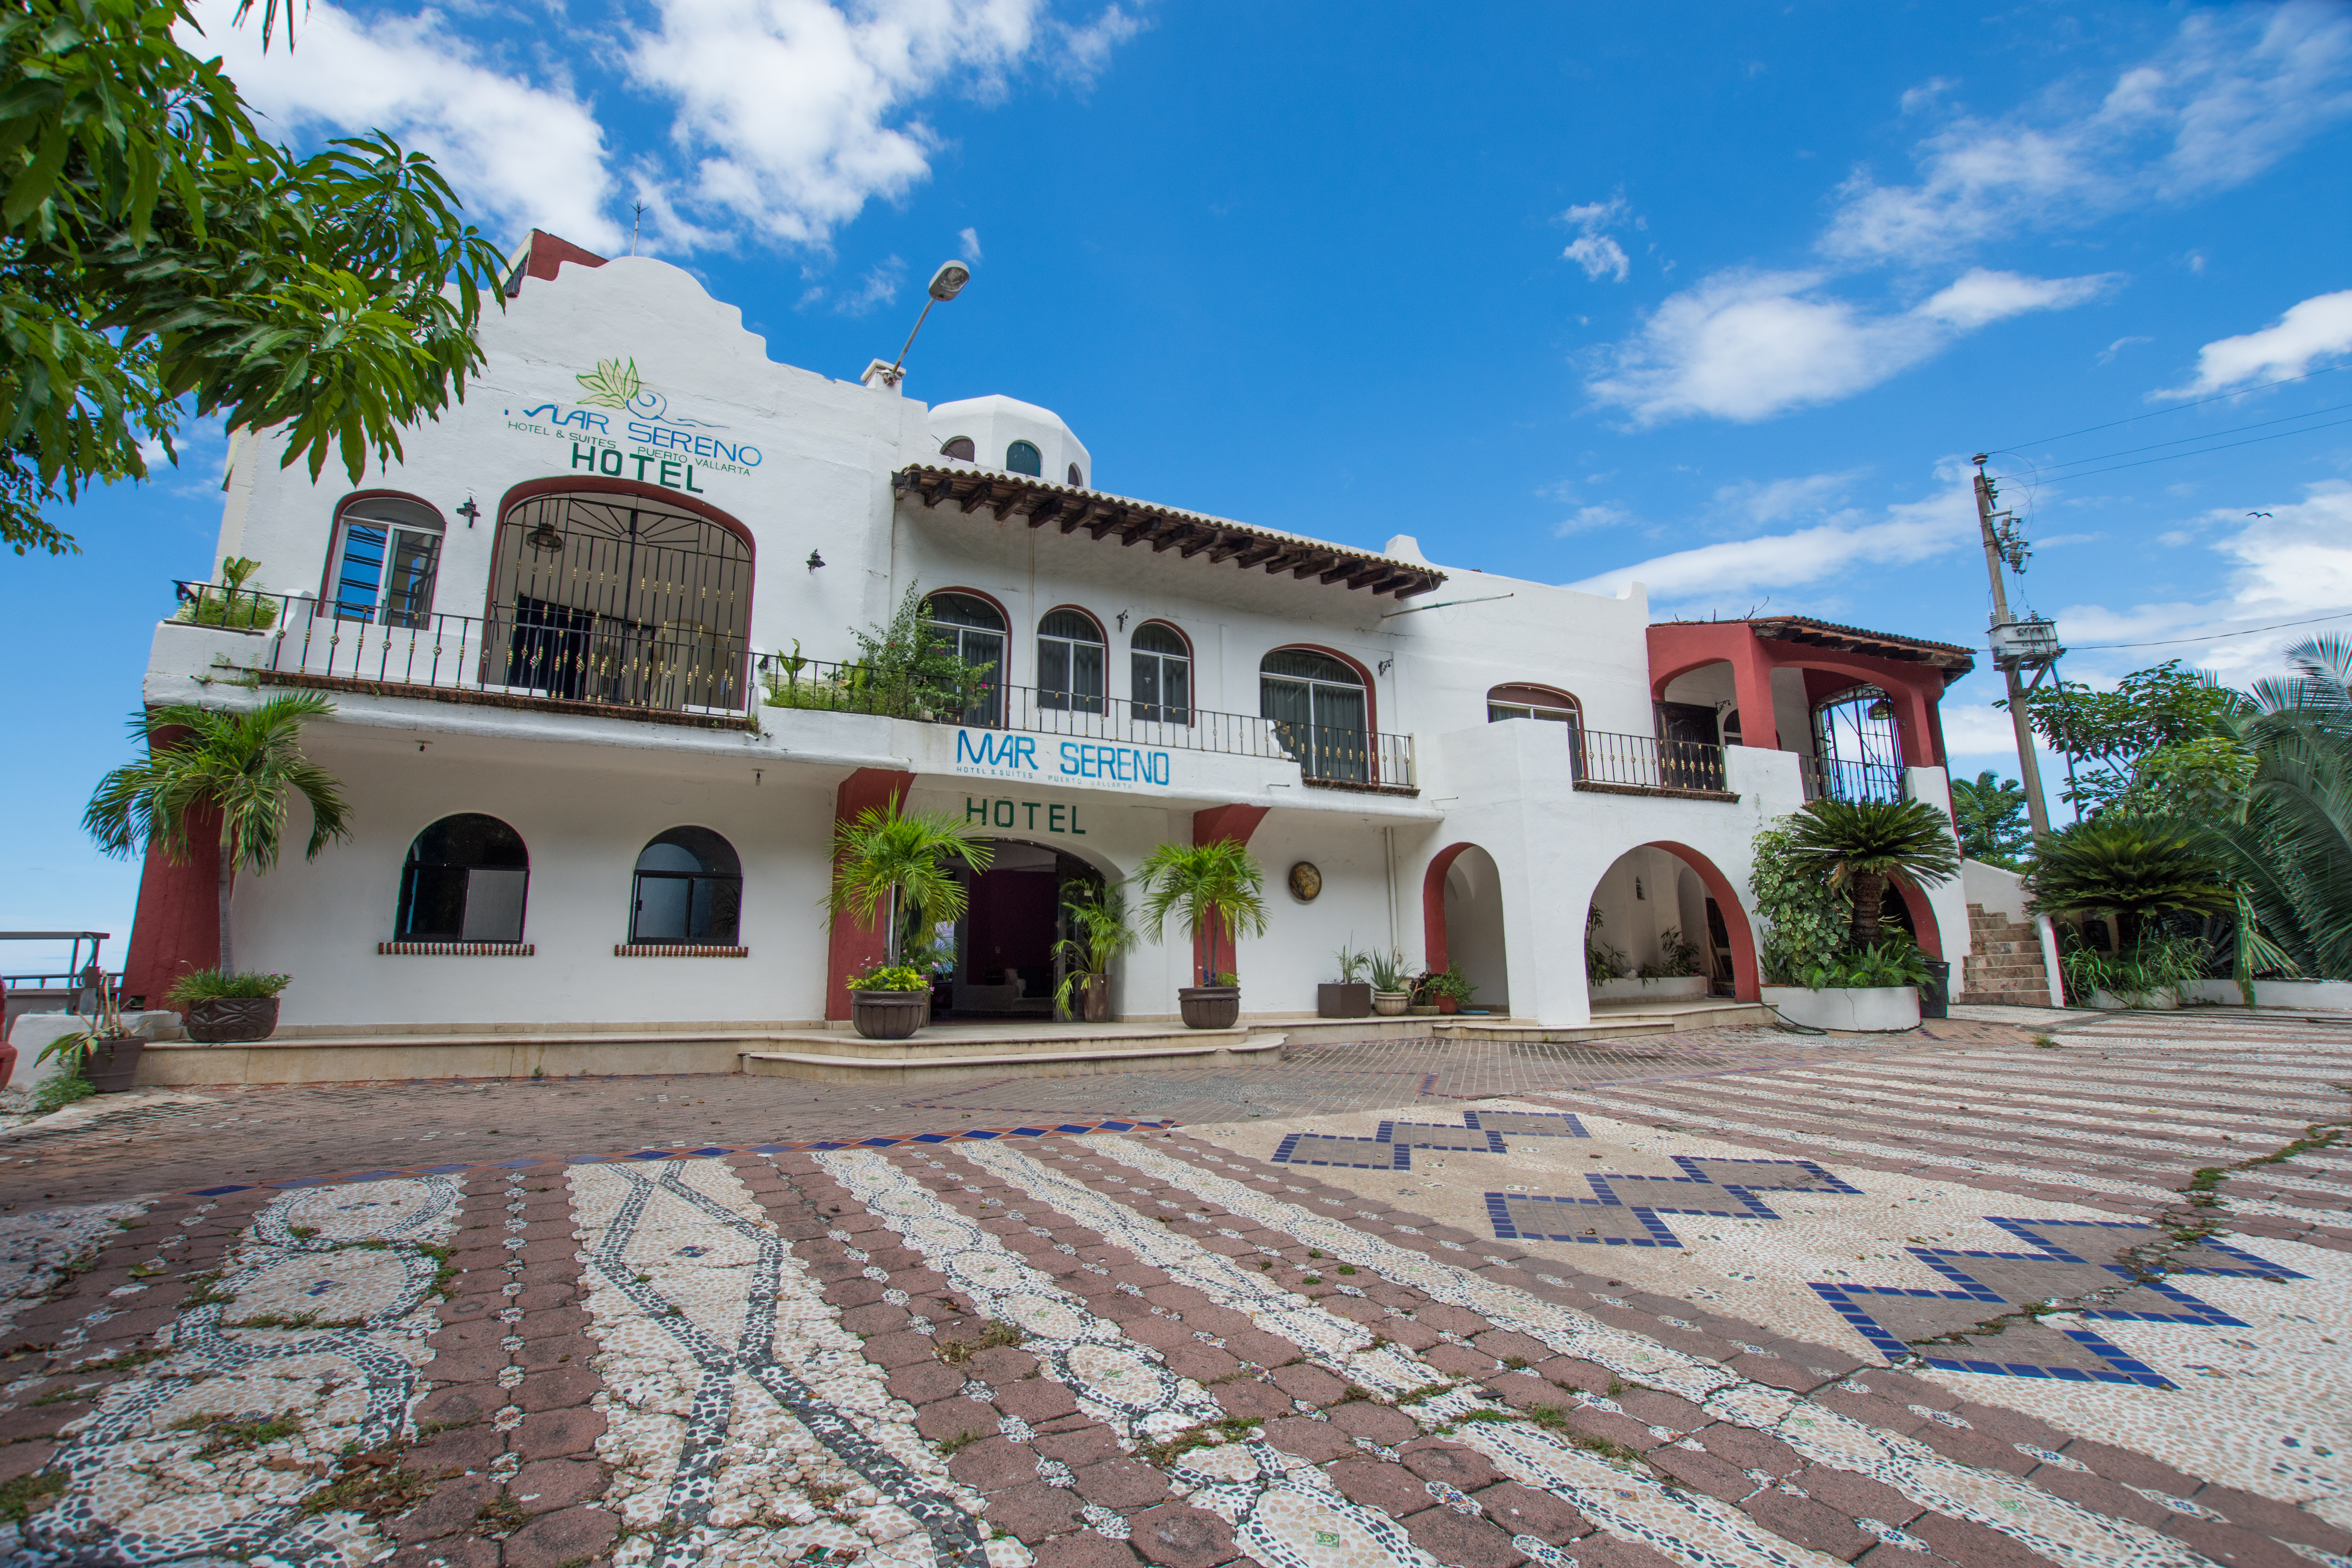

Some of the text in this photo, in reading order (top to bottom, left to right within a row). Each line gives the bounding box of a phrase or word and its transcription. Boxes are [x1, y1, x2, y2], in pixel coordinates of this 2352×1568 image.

[508, 421, 750, 476] HOTEL & SUITES PUERTO VALLARTA
[523, 404, 762, 466] MAR SERENO
[572, 442, 704, 494] HOTEL
[956, 730, 1170, 786] MAR SERENO
[957, 766, 986, 775] HOTEL
[1000, 769, 1033, 779] SUITES
[1048, 775, 1082, 784] PUERTO
[1091, 780, 1132, 789] VALLARTA
[966, 797, 1086, 835] HOTEL
